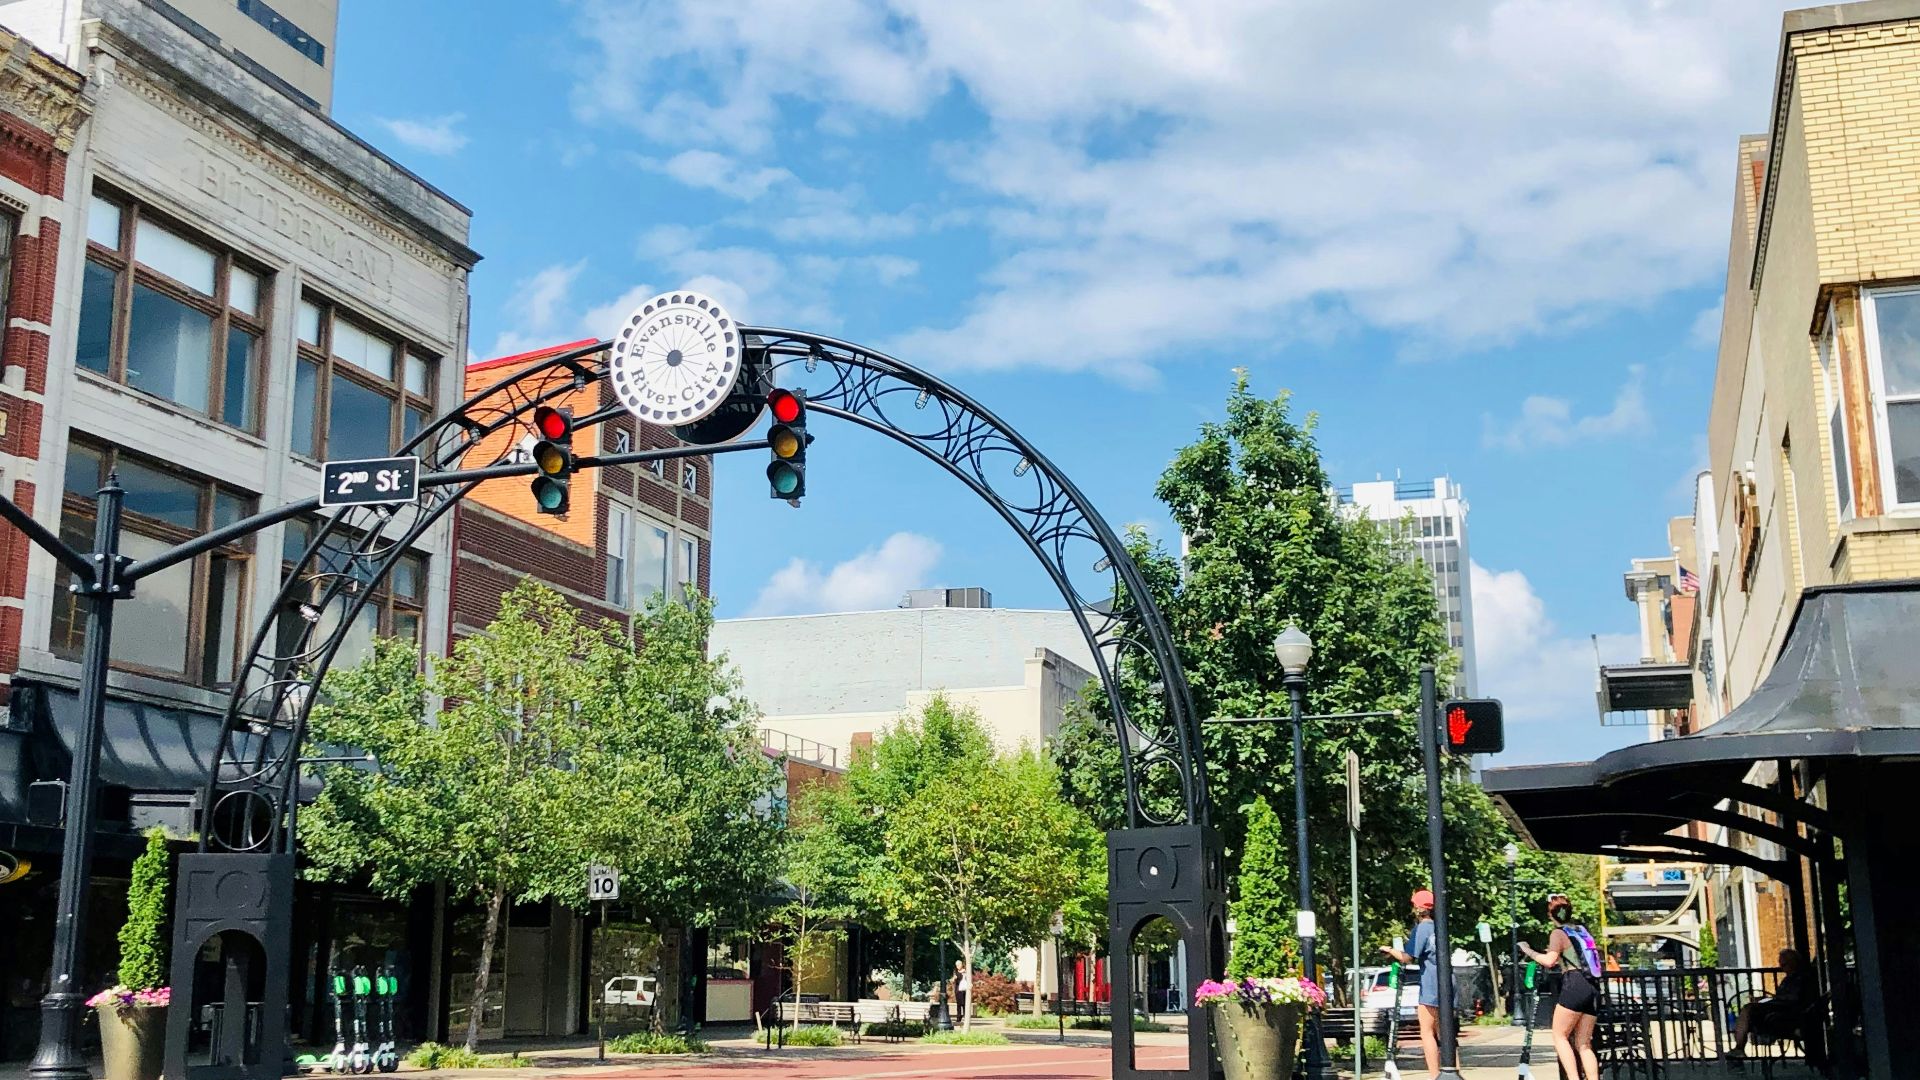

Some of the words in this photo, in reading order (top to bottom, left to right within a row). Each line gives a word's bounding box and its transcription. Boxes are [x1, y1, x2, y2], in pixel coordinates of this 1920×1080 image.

[199, 160, 376, 287] BITTERMAN
[630, 314, 717, 359] Evansville
[630, 367, 677, 405] River
[681, 361, 719, 401] City
[338, 471, 369, 494] 2ND
[375, 469, 402, 492] St
[594, 878, 614, 894] 10
